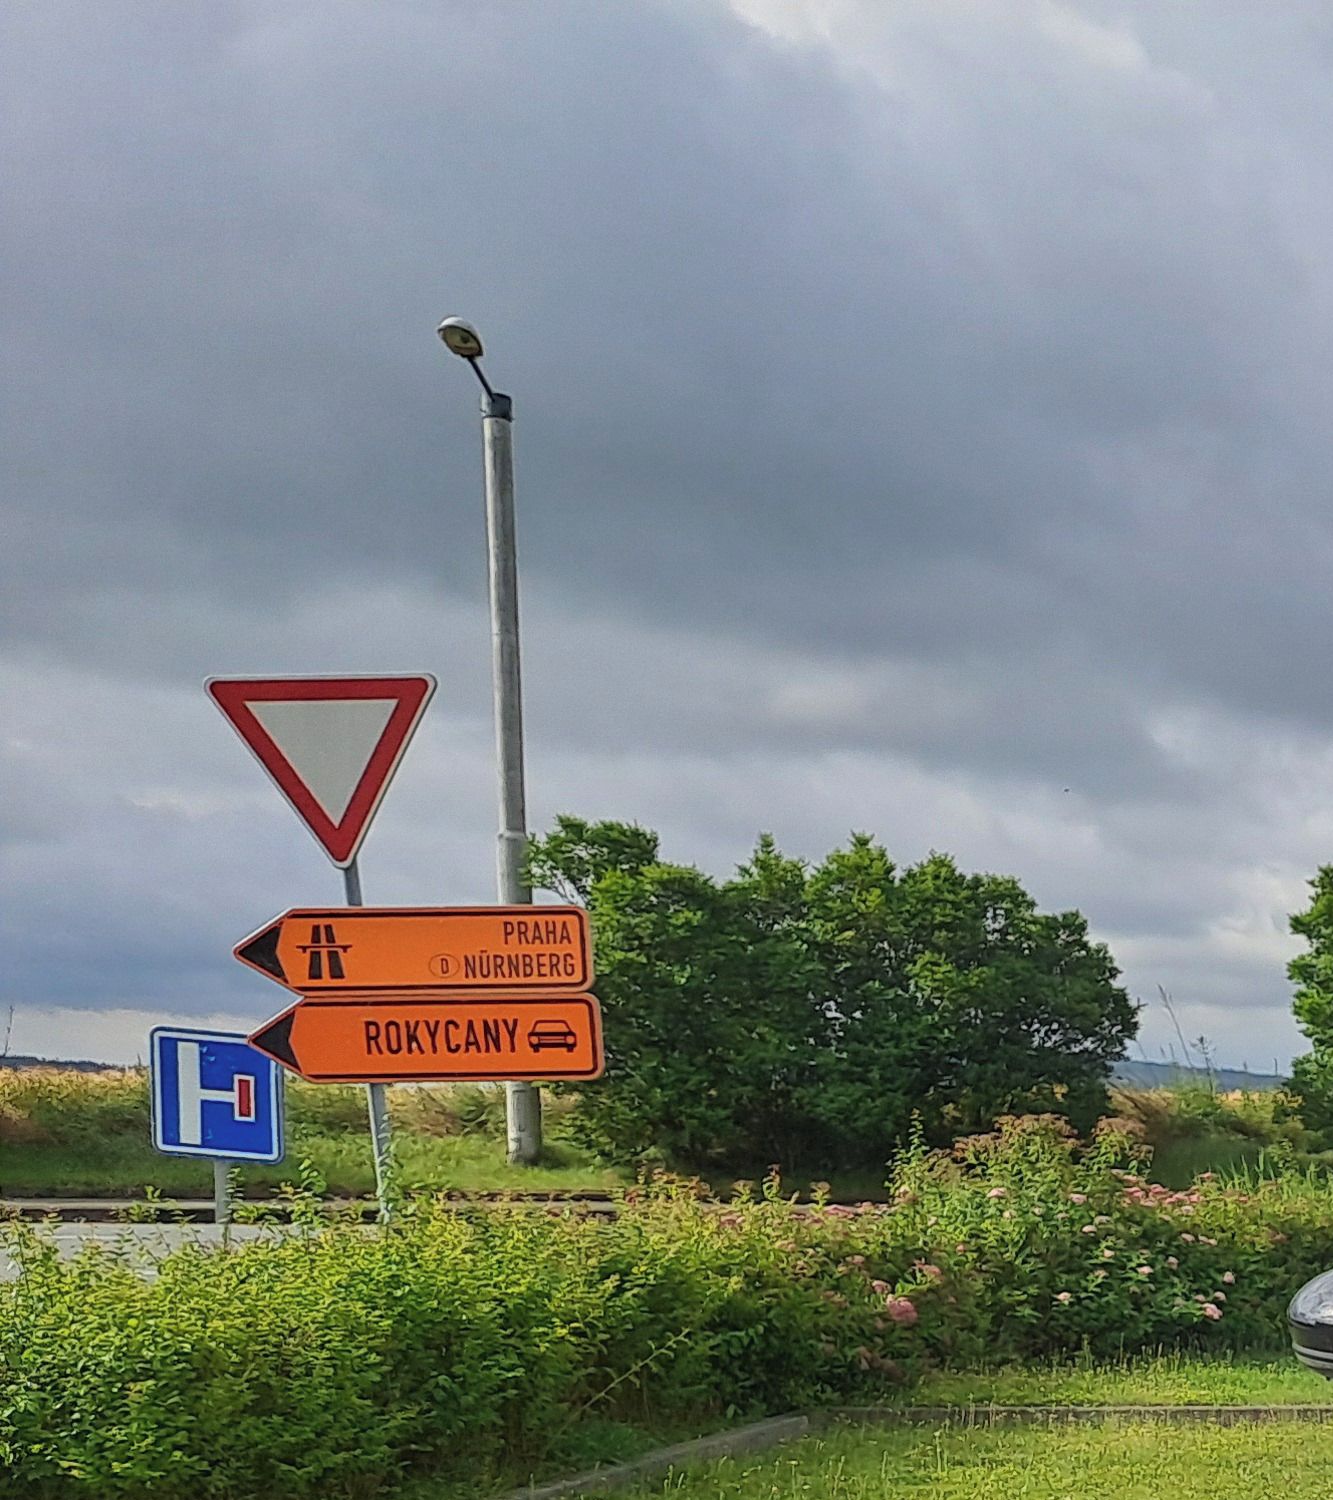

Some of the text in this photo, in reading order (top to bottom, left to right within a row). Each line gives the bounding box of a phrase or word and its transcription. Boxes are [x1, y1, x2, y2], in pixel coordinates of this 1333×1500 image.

[503, 920, 572, 945] PRAHA
[440, 950, 576, 979] D NÜRNBERG
[364, 1018, 519, 1056] ROKYCANY
